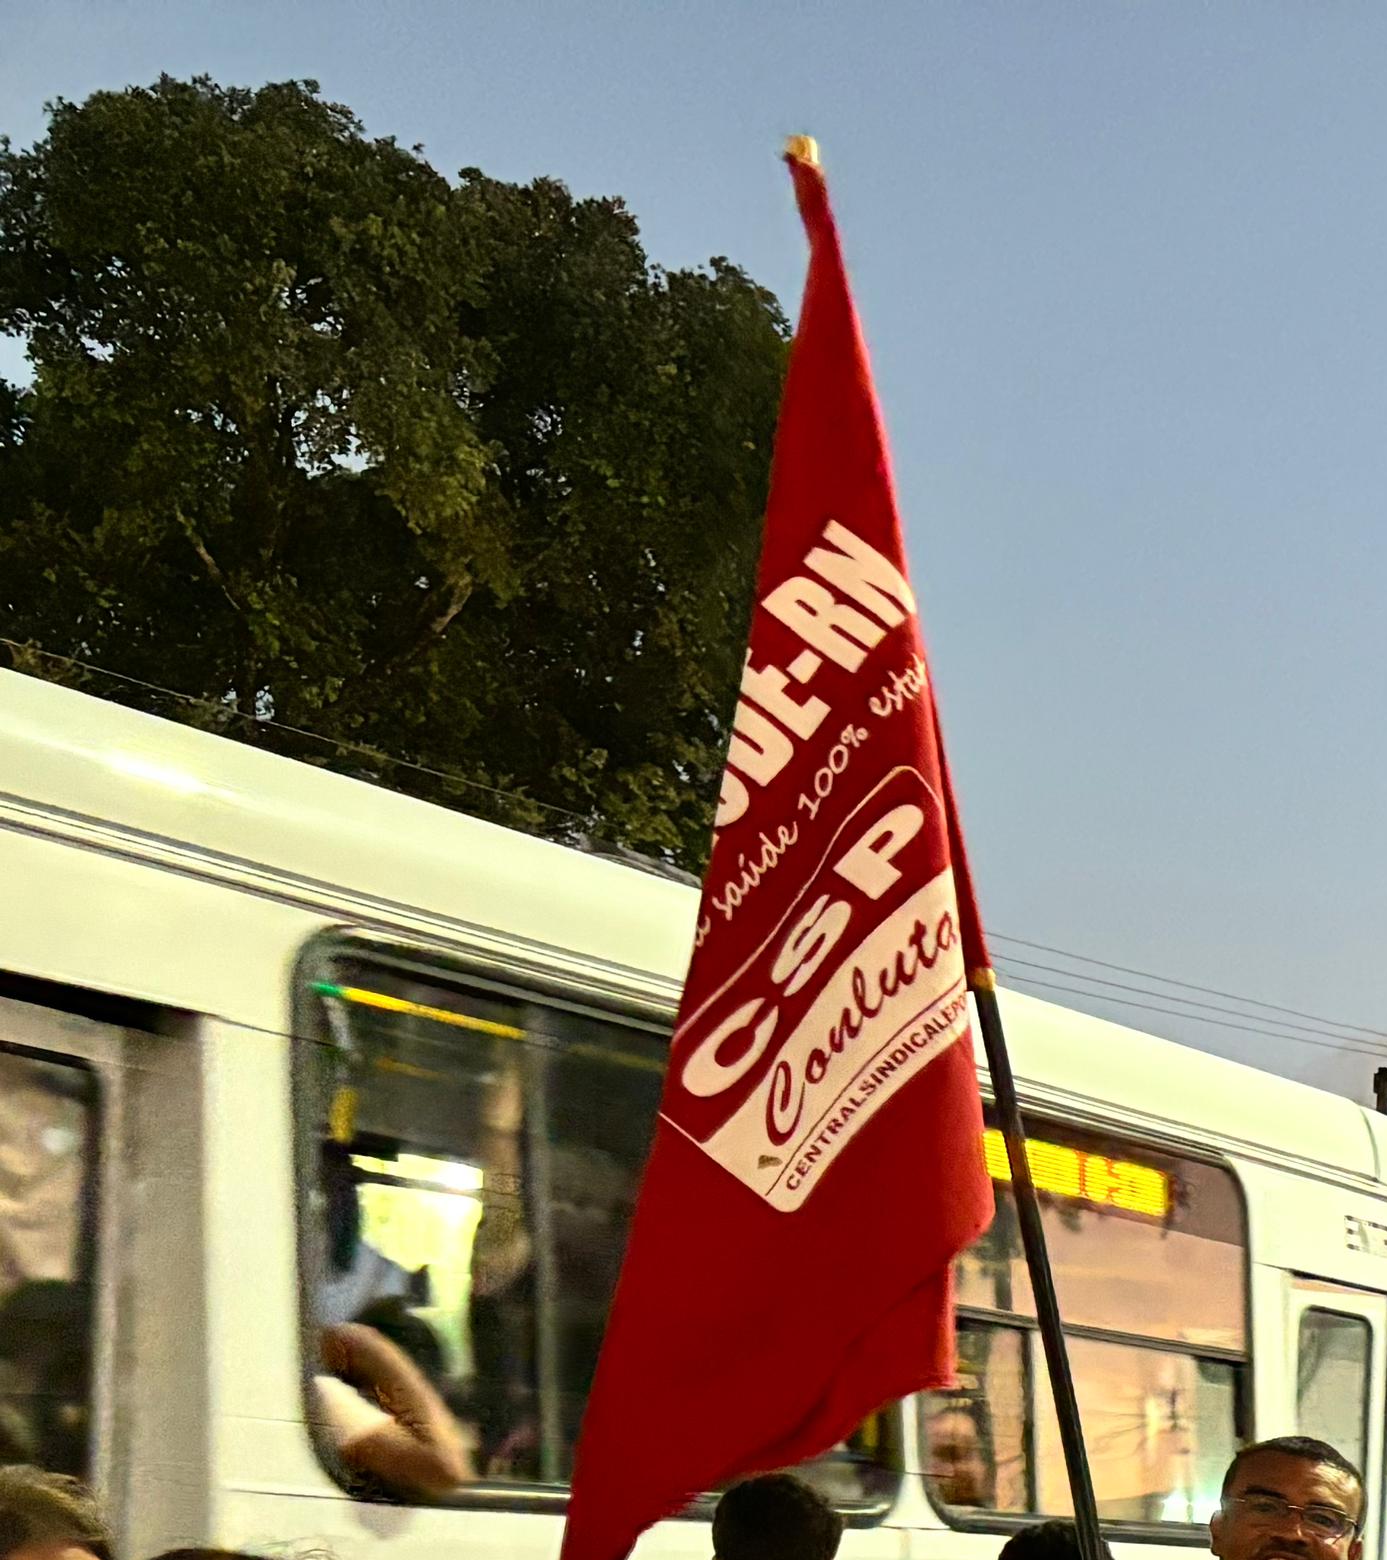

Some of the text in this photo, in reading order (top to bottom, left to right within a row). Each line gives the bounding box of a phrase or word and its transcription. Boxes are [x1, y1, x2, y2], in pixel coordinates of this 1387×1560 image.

[797, 723, 869, 820] 100%
[682, 804, 924, 1098] CSP
[765, 910, 958, 1147] Conluta
[785, 1096, 861, 1192] CENTRAL
[861, 1016, 944, 1098] SINDICAL
